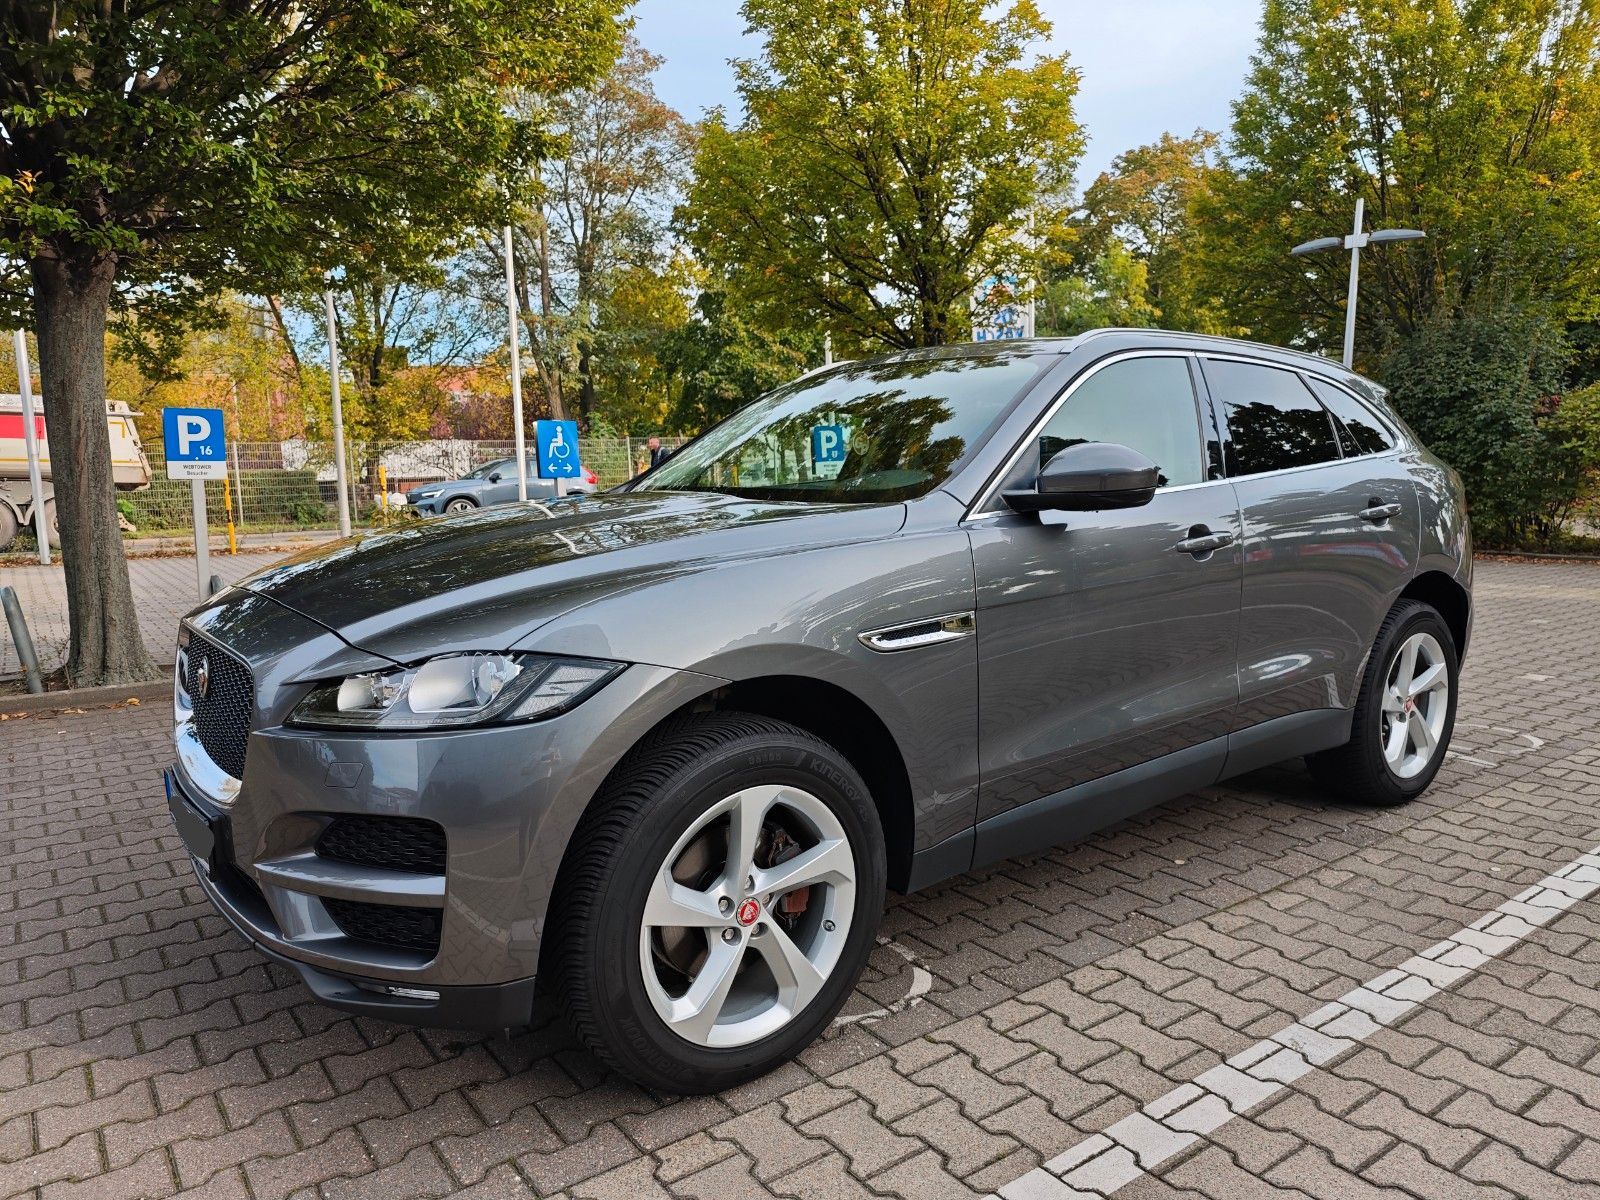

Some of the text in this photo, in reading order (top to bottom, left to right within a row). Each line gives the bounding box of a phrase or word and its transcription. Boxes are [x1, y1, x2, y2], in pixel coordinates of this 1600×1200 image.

[177, 415, 211, 455] P
[200, 445, 213, 456] 16
[820, 430, 838, 459] P
[809, 758, 863, 801] KINERGY
